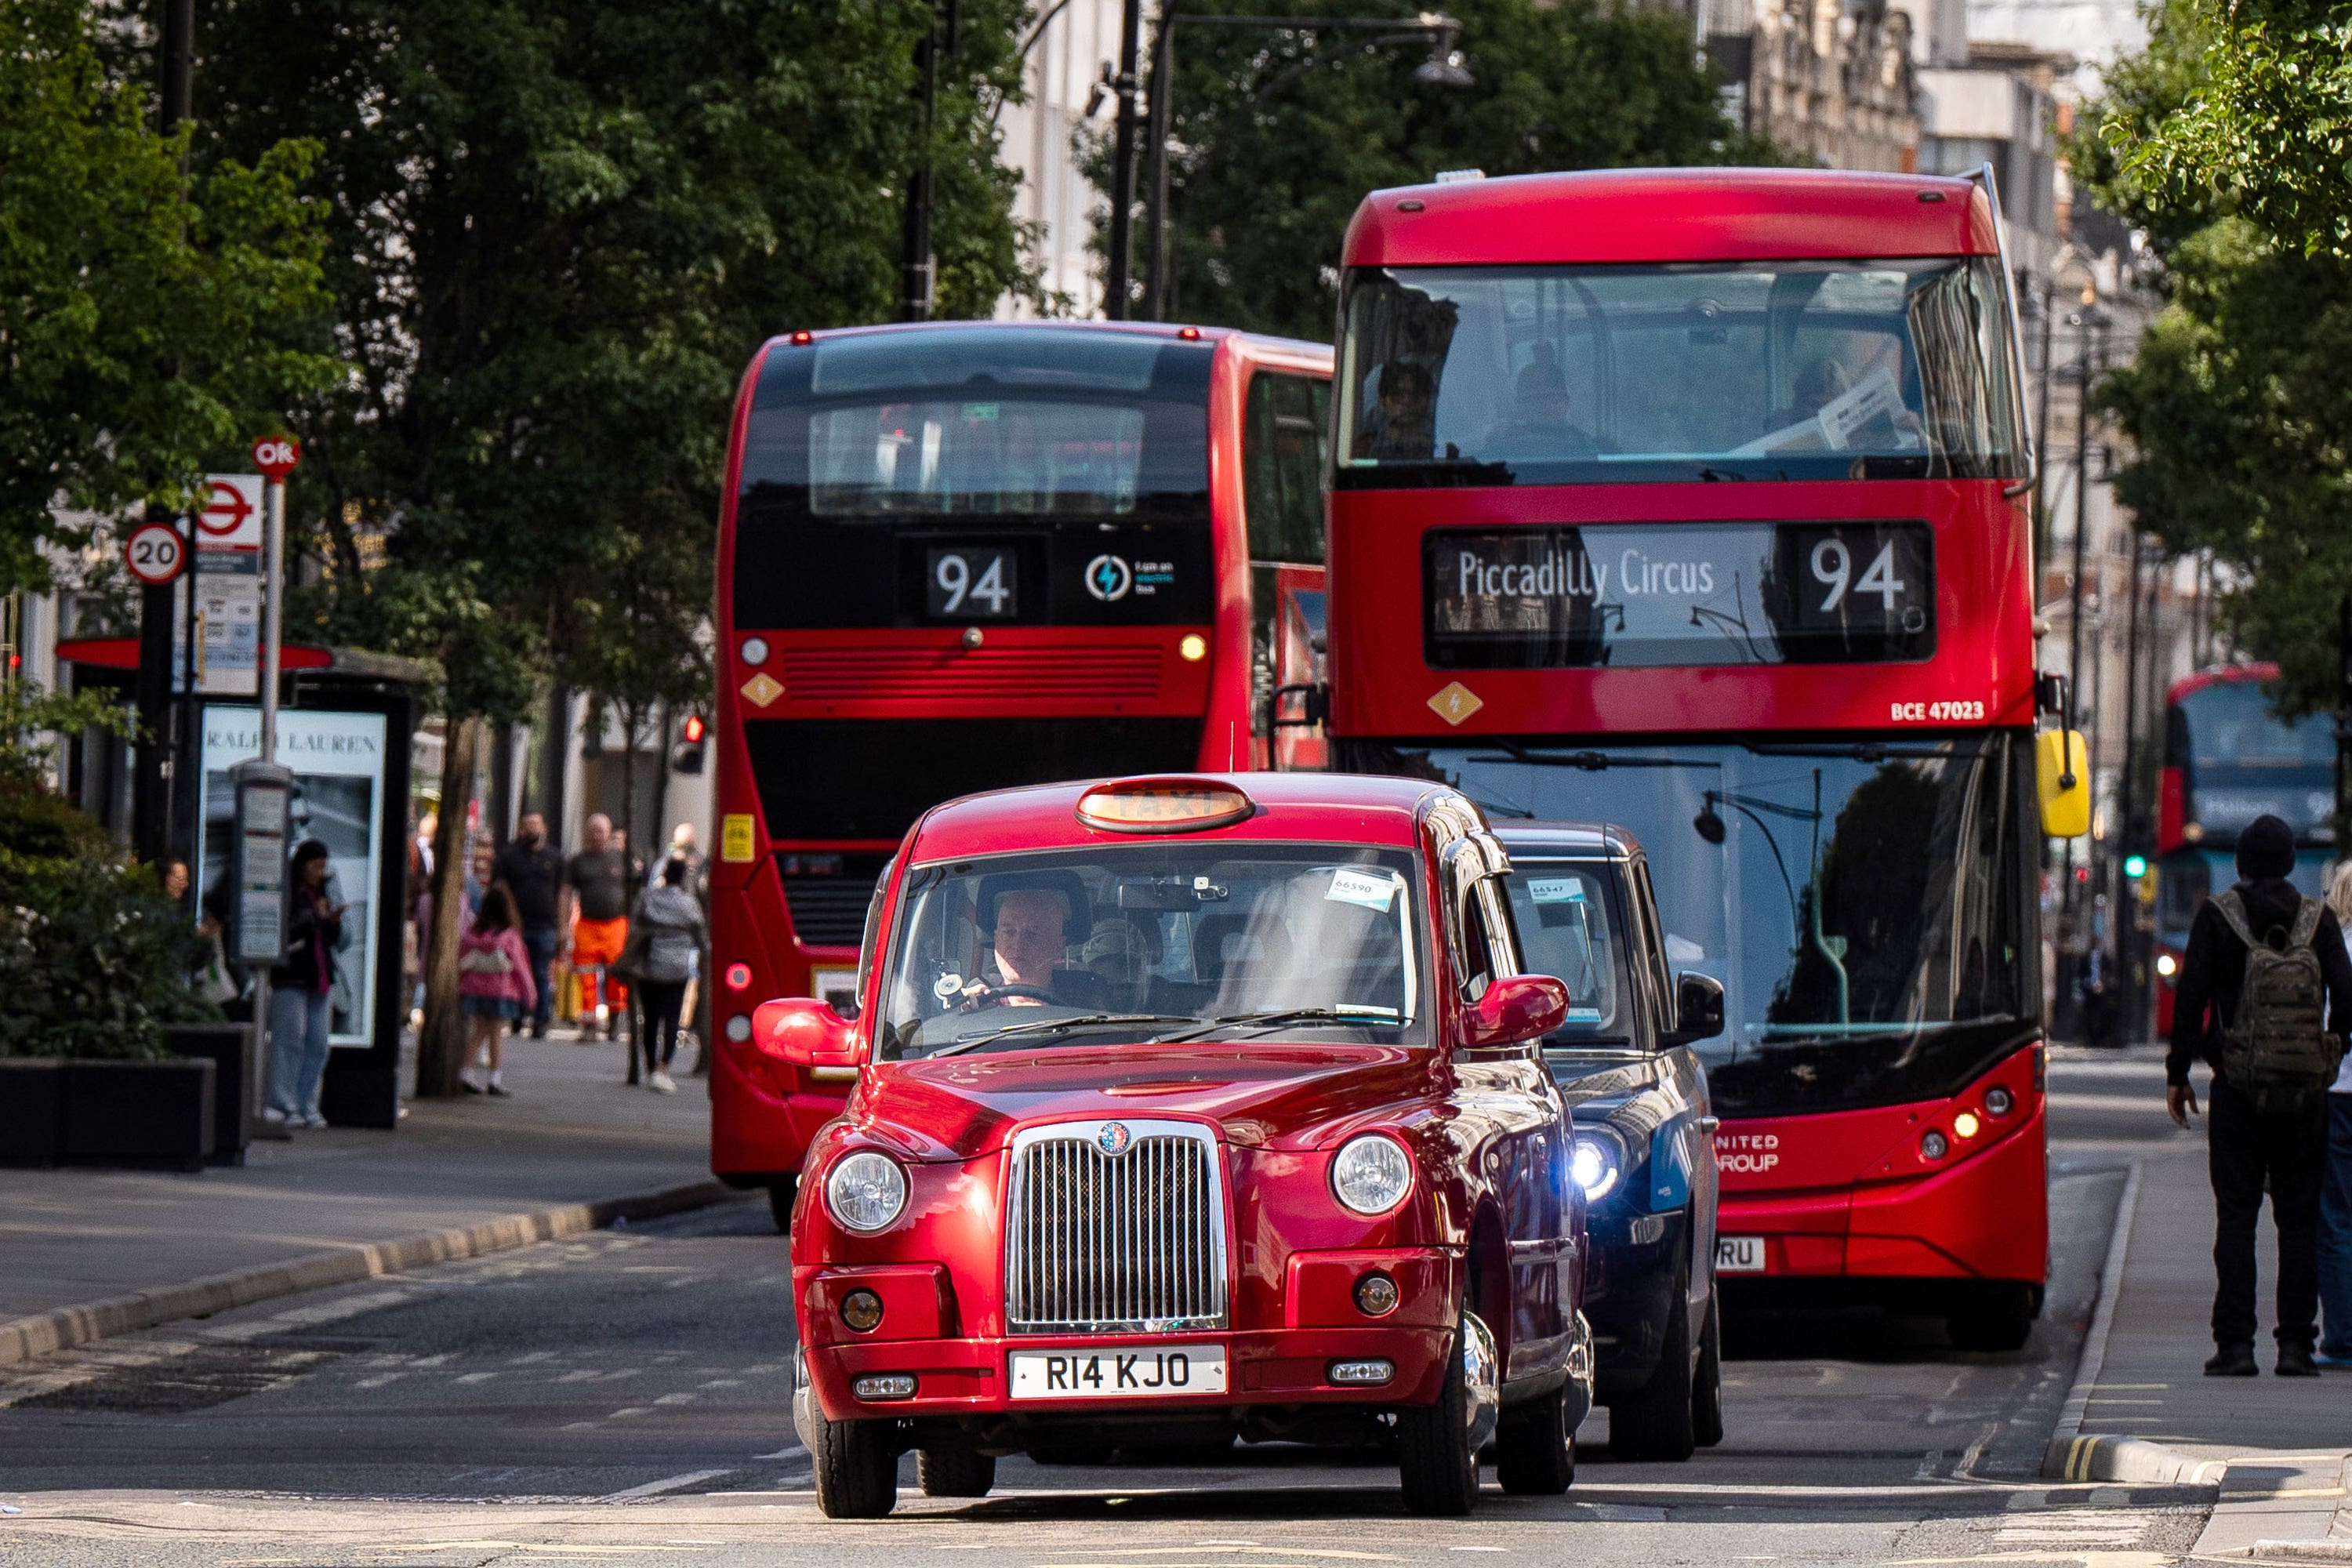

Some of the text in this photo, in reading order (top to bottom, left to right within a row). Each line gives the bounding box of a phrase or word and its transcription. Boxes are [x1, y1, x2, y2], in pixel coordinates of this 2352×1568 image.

[136, 541, 175, 564] 20
[936, 554, 1009, 613] 94
[1459, 548, 1714, 608] Piccadilly Circus
[1810, 538, 1905, 613] 94
[1890, 701, 1984, 721] BCE 47023
[289, 733, 376, 754] LAUREN
[1113, 789, 1212, 817] TAXI
[1335, 880, 1371, 893] 66590
[1715, 1134, 1779, 1150] NITED
[1719, 1153, 1780, 1173] ROUP
[1046, 1353, 1189, 1390] R14 KJO
